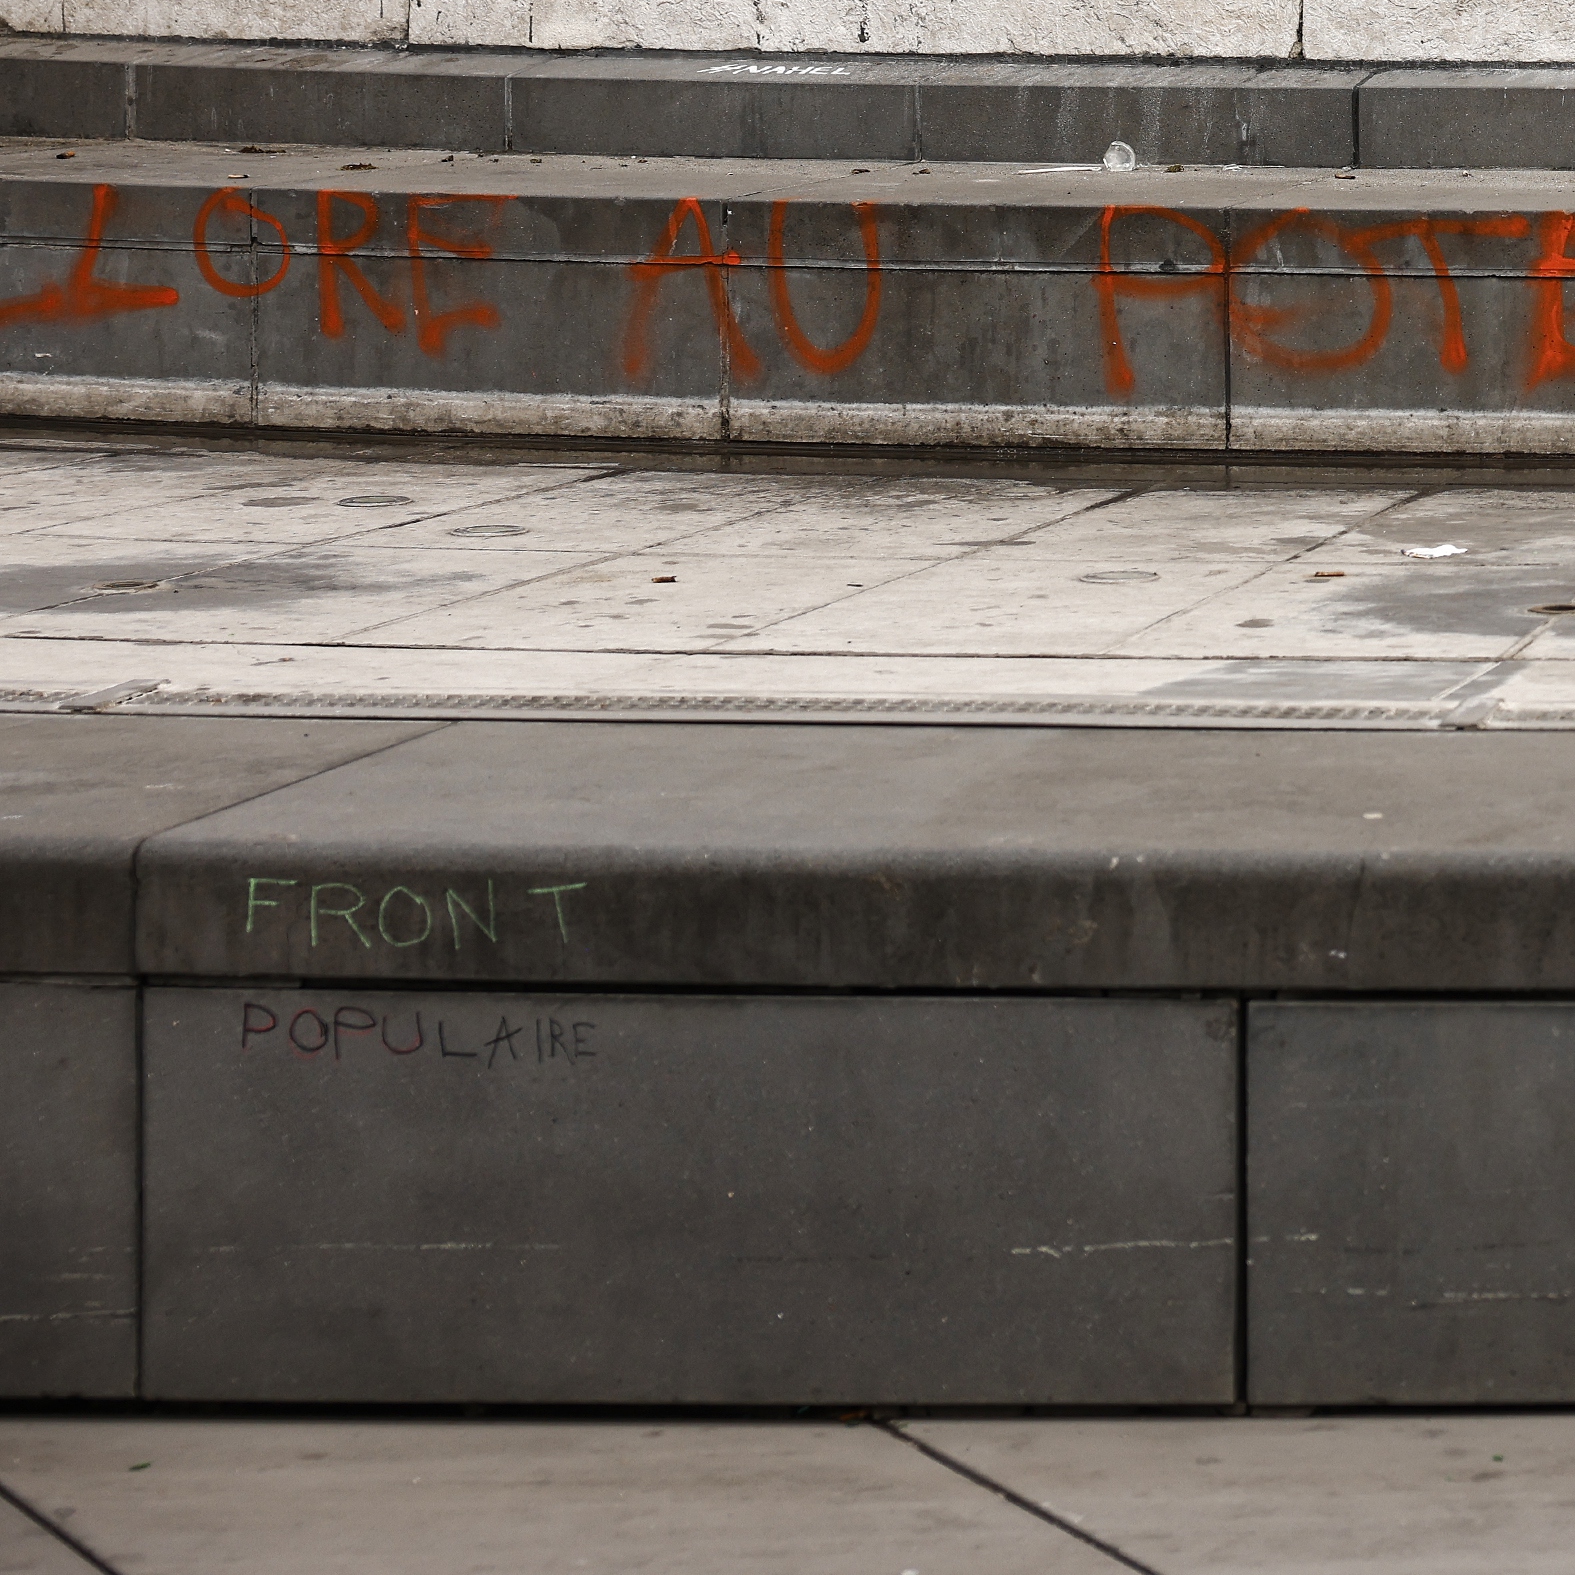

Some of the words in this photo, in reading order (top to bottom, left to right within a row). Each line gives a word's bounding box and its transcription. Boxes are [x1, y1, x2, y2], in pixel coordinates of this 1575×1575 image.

[696, 64, 851, 75] #NAHEL
[622, 197, 884, 386] AU
[245, 877, 588, 951] FRONT
[239, 1001, 600, 1070] POPULAIRE
